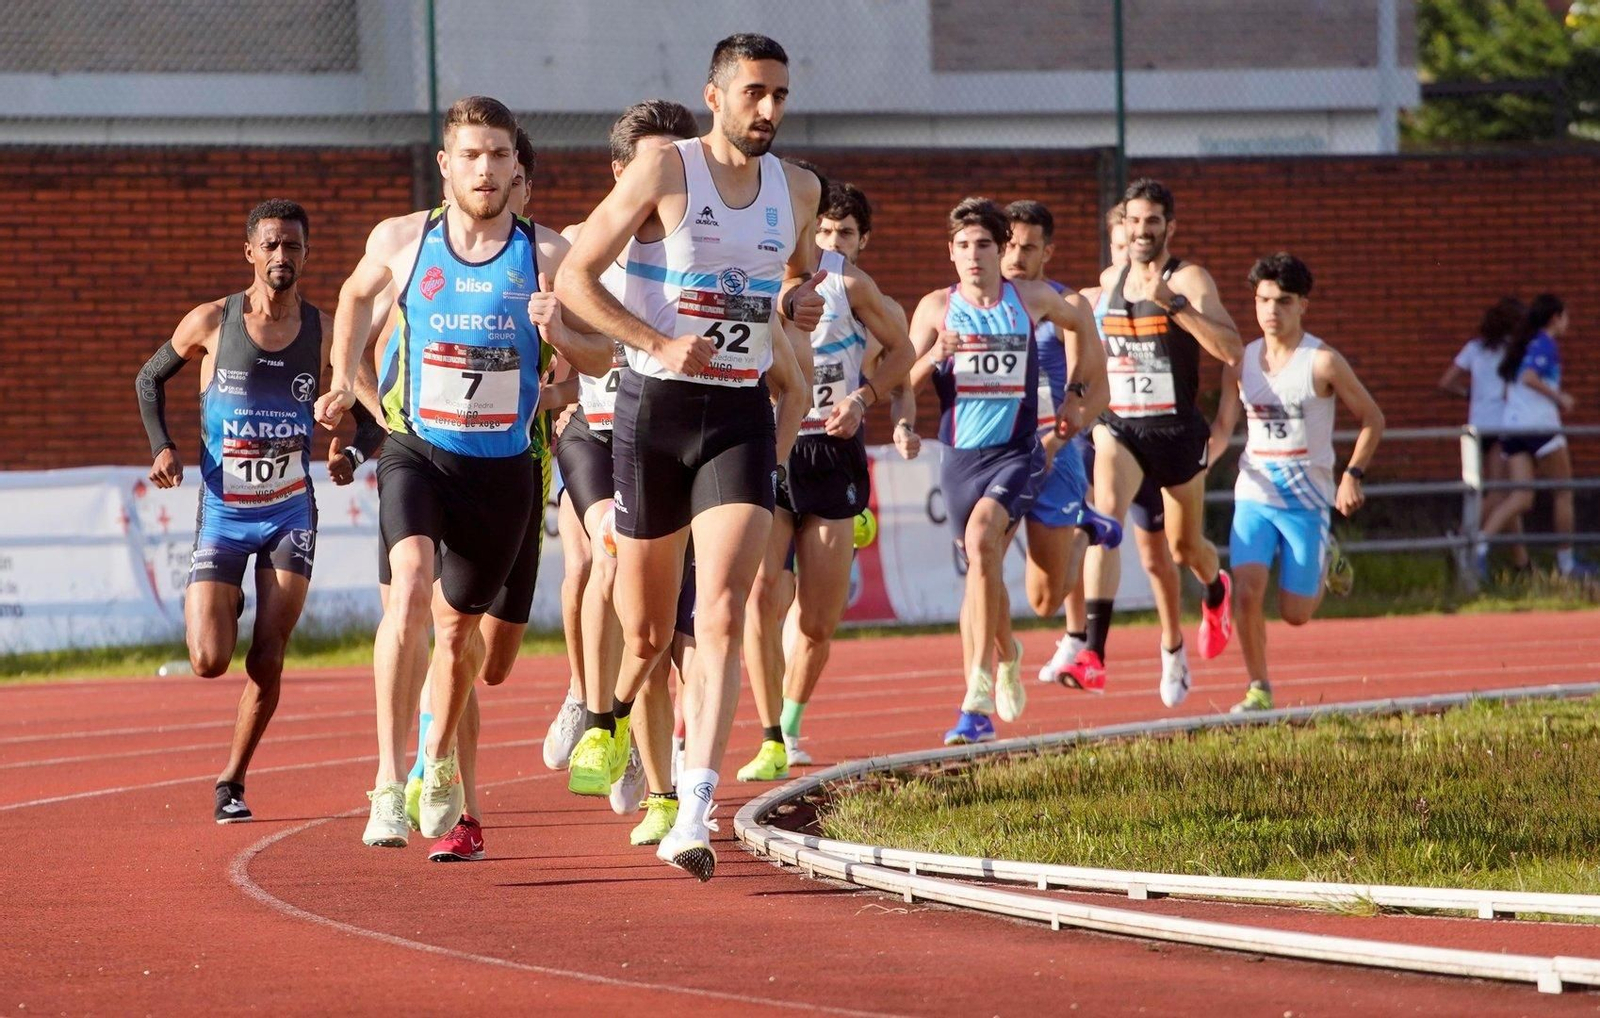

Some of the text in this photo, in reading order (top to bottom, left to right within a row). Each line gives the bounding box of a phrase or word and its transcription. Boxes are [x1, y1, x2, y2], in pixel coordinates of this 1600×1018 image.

[429, 313, 516, 333] QUERCIA
[488, 332, 516, 340] GRUPO
[709, 362, 733, 372] VIGO
[968, 353, 1017, 374] 109
[461, 372, 483, 400] 7
[1126, 376, 1153, 394] 12
[234, 408, 297, 418] CLUB ATLETISMO
[456, 409, 478, 419] VIGO
[222, 419, 308, 439] NARÓN
[435, 416, 461, 427] terreo
[479, 420, 500, 429] xogo
[1264, 422, 1287, 439] 13
[237, 455, 290, 482] 107
